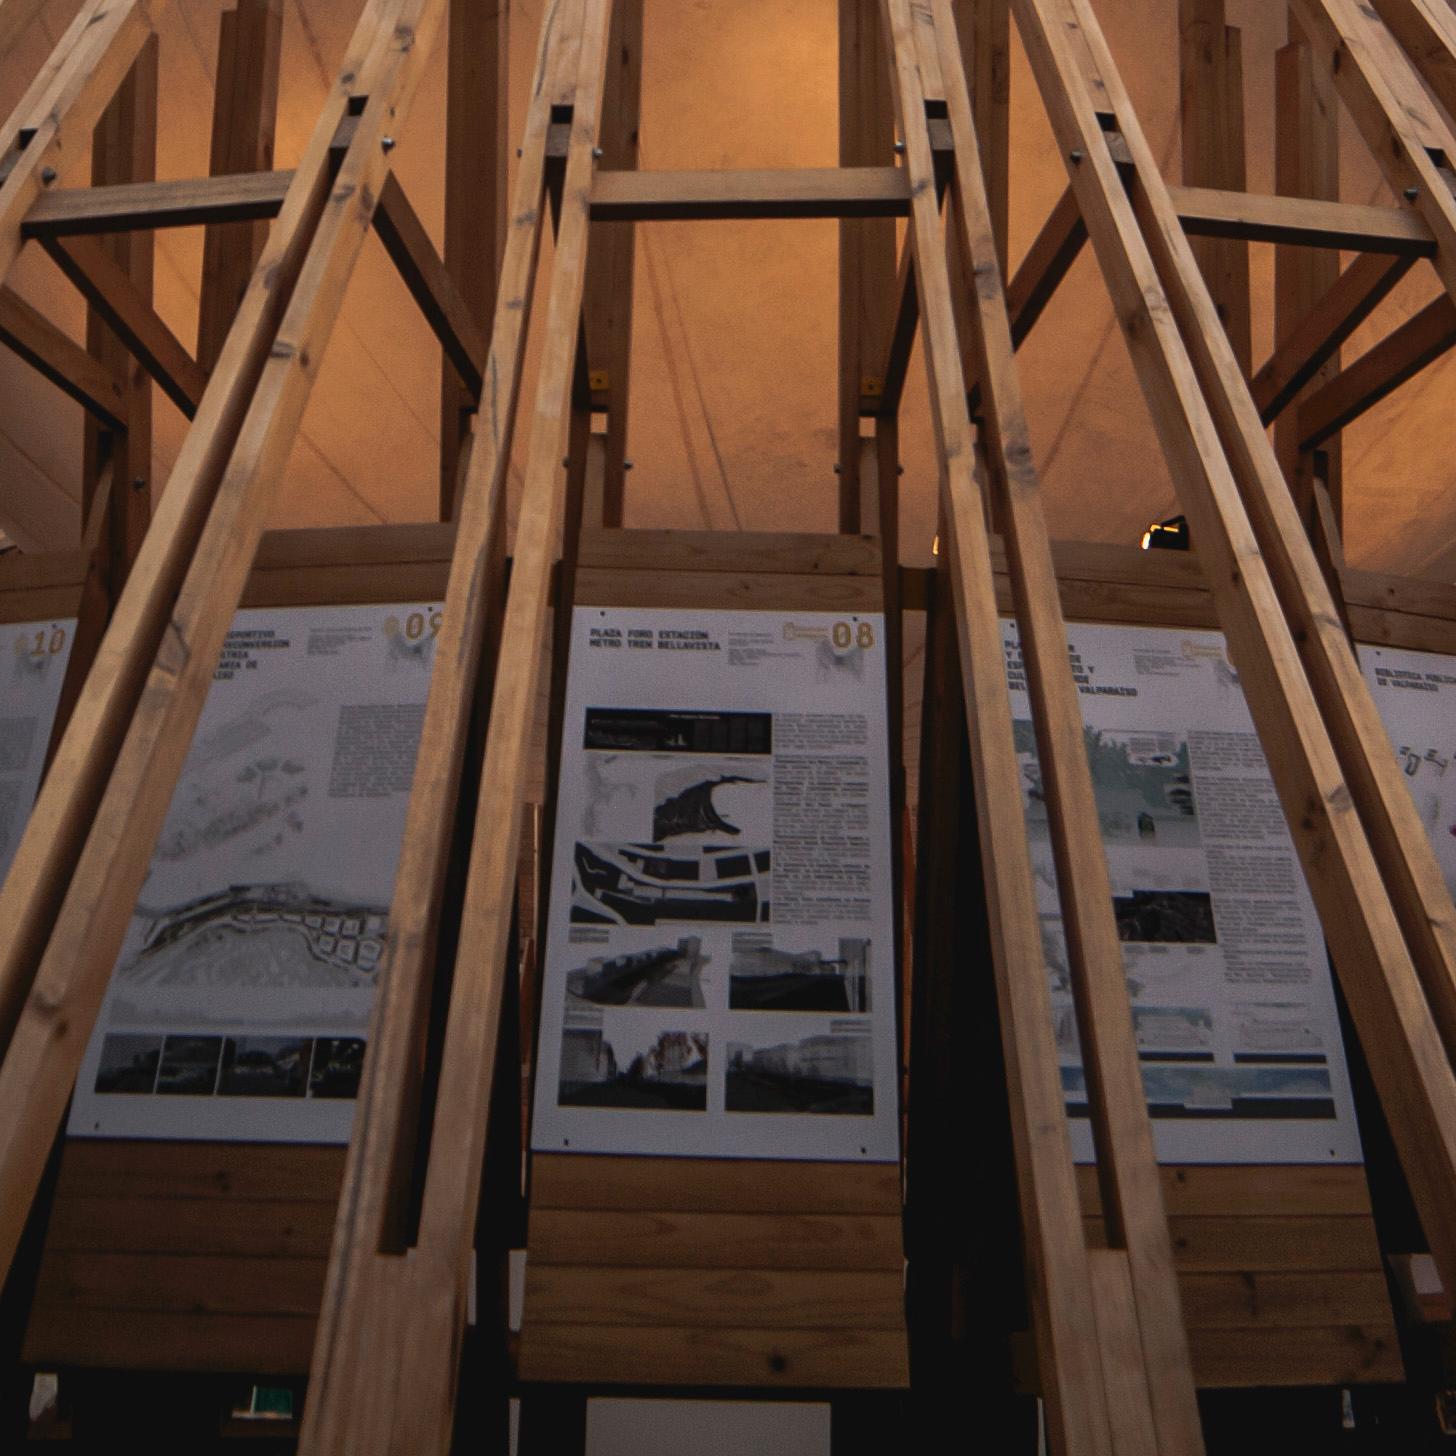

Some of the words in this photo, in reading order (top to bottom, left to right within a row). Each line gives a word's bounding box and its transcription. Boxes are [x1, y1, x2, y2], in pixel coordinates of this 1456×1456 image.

[30, 629, 66, 657] 10
[590, 628, 622, 638] PLAZA
[832, 622, 874, 650] 08
[589, 638, 622, 649] METRO
[657, 640, 721, 650] BELLAVISTA
